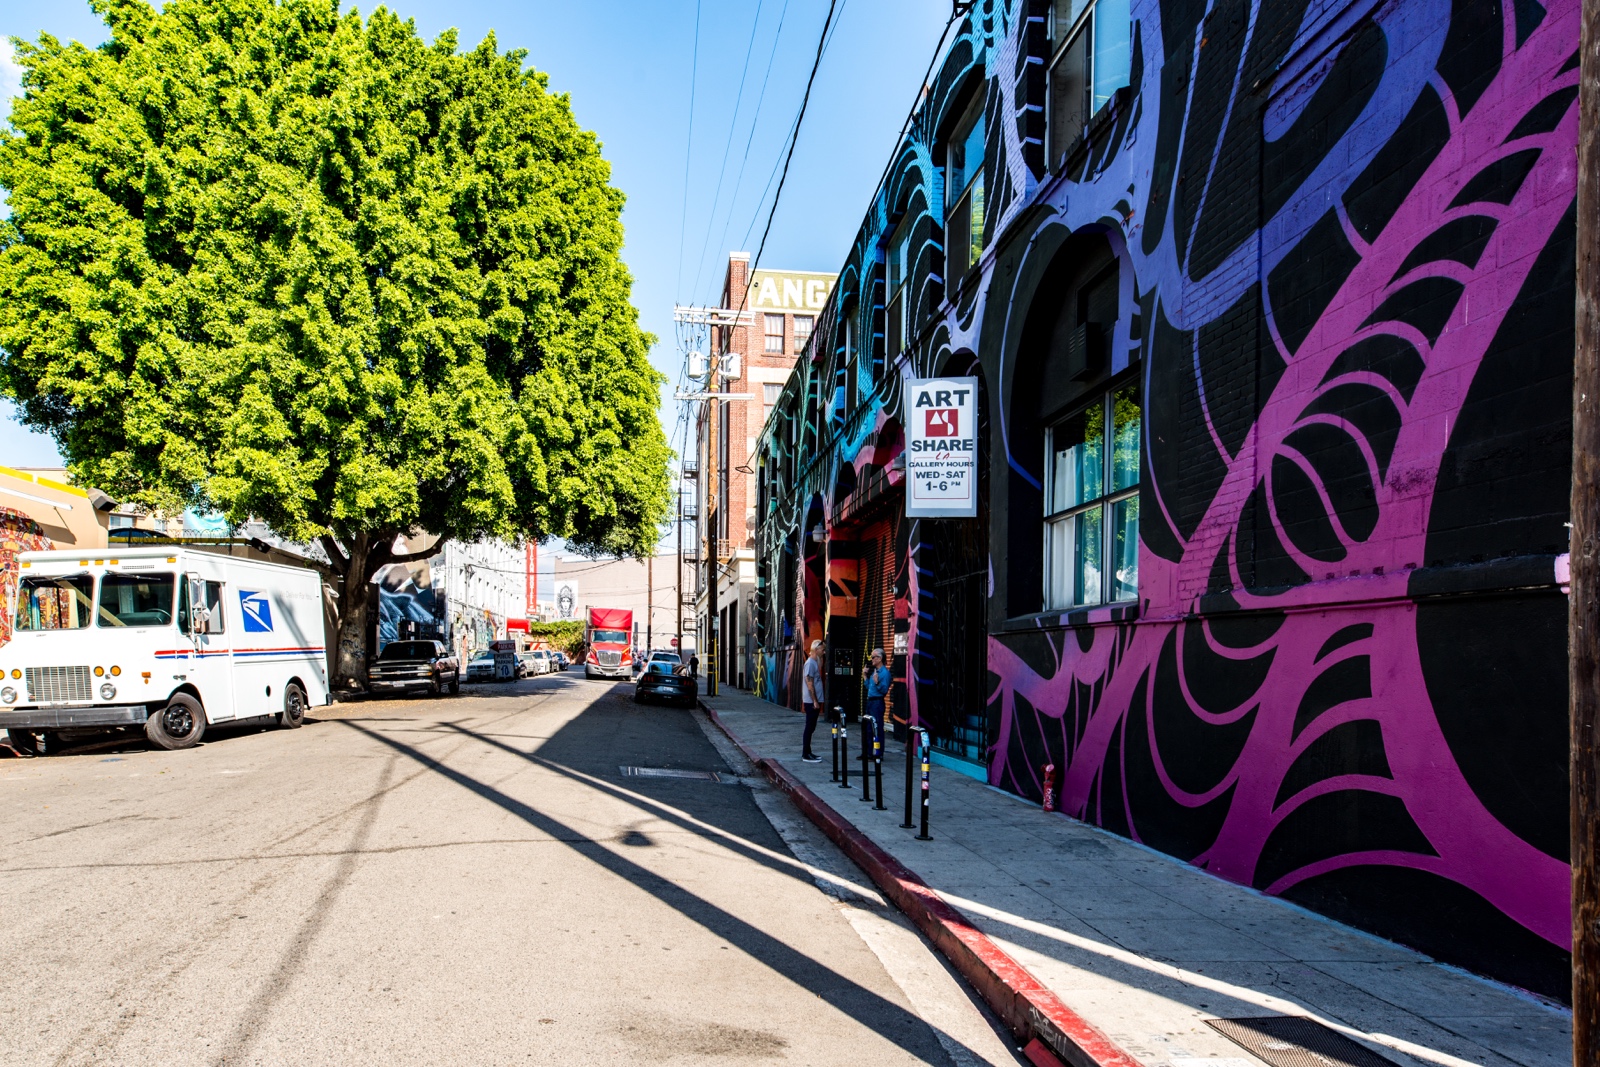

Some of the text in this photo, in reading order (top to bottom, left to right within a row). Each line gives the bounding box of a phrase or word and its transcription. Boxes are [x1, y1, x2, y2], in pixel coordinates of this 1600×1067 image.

[915, 389, 970, 408] ART
[911, 439, 974, 452] SHARE
[925, 481, 948, 491] 1-6
